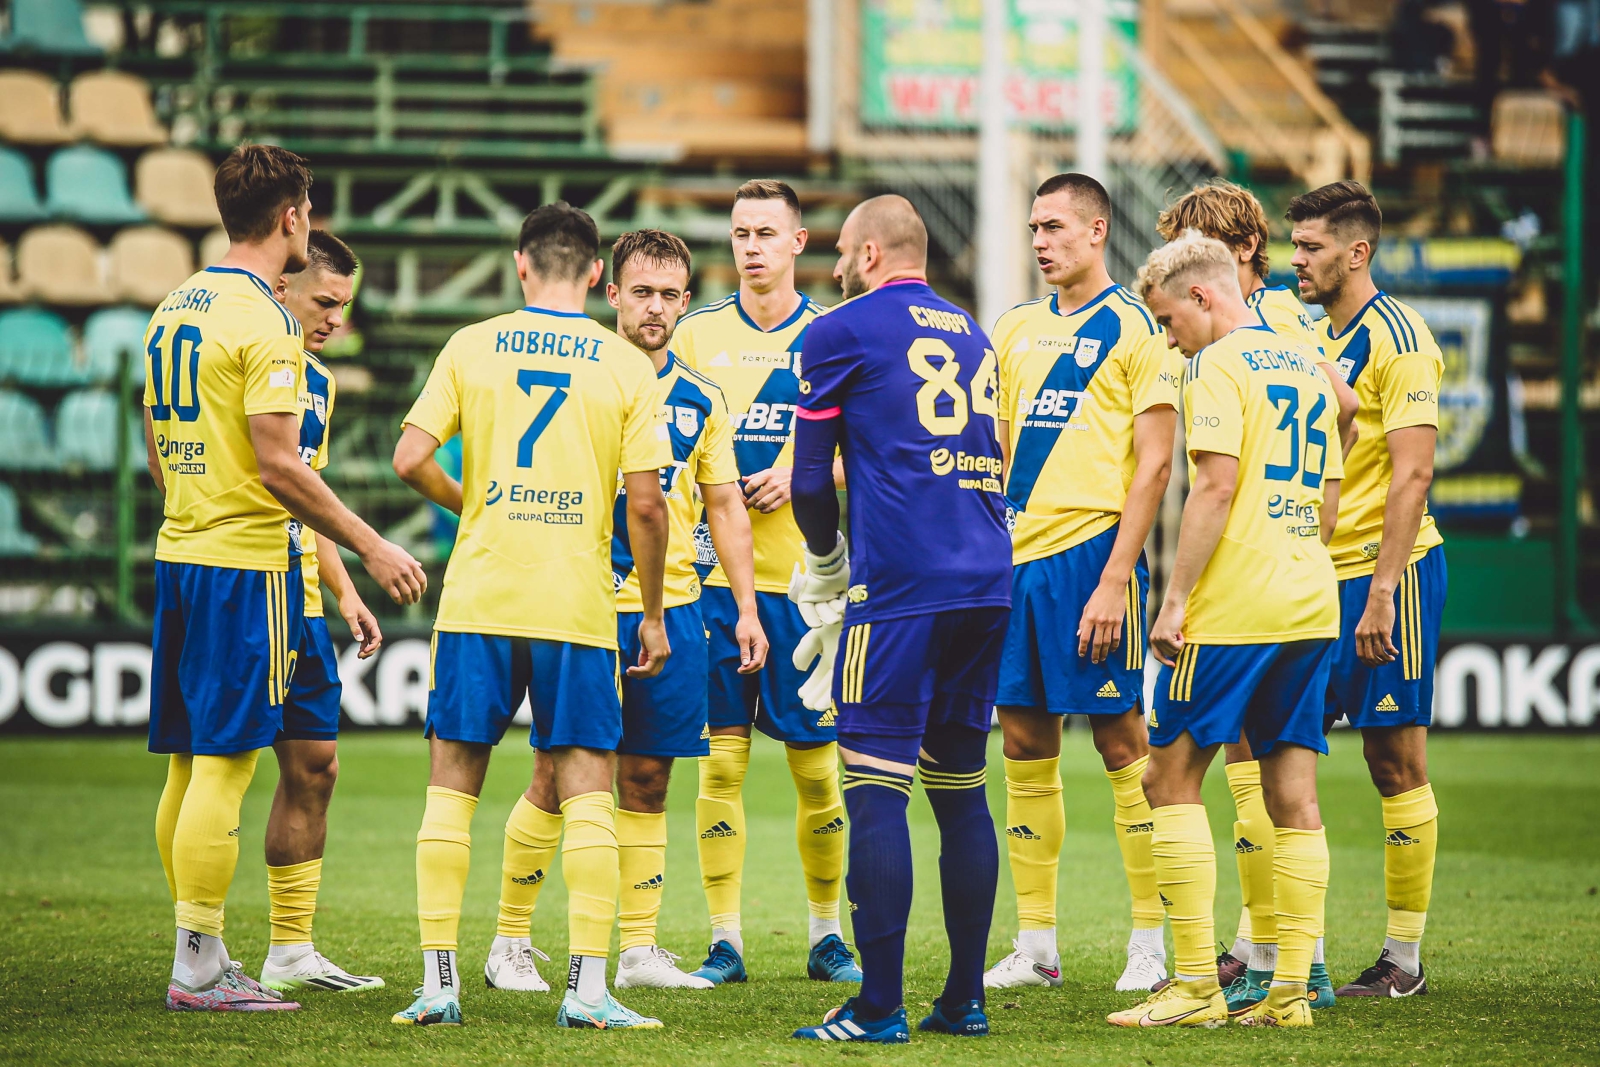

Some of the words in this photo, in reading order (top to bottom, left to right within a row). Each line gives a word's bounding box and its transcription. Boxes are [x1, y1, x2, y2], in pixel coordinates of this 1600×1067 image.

[909, 305, 972, 336] CHUDY
[496, 331, 604, 362] KOBACKI
[742, 355, 785, 363] FORTUNA
[147, 324, 203, 422] 10
[1241, 350, 1327, 384] BEDNARS
[906, 337, 1000, 443] 84
[516, 369, 572, 468] 7
[1264, 384, 1327, 489] 36
[509, 485, 583, 510] Energa
[508, 512, 542, 522] GRUPA
[545, 513, 582, 524] ORLEN
[701, 830, 737, 840] adidas
[966, 1023, 987, 1031] COPA
